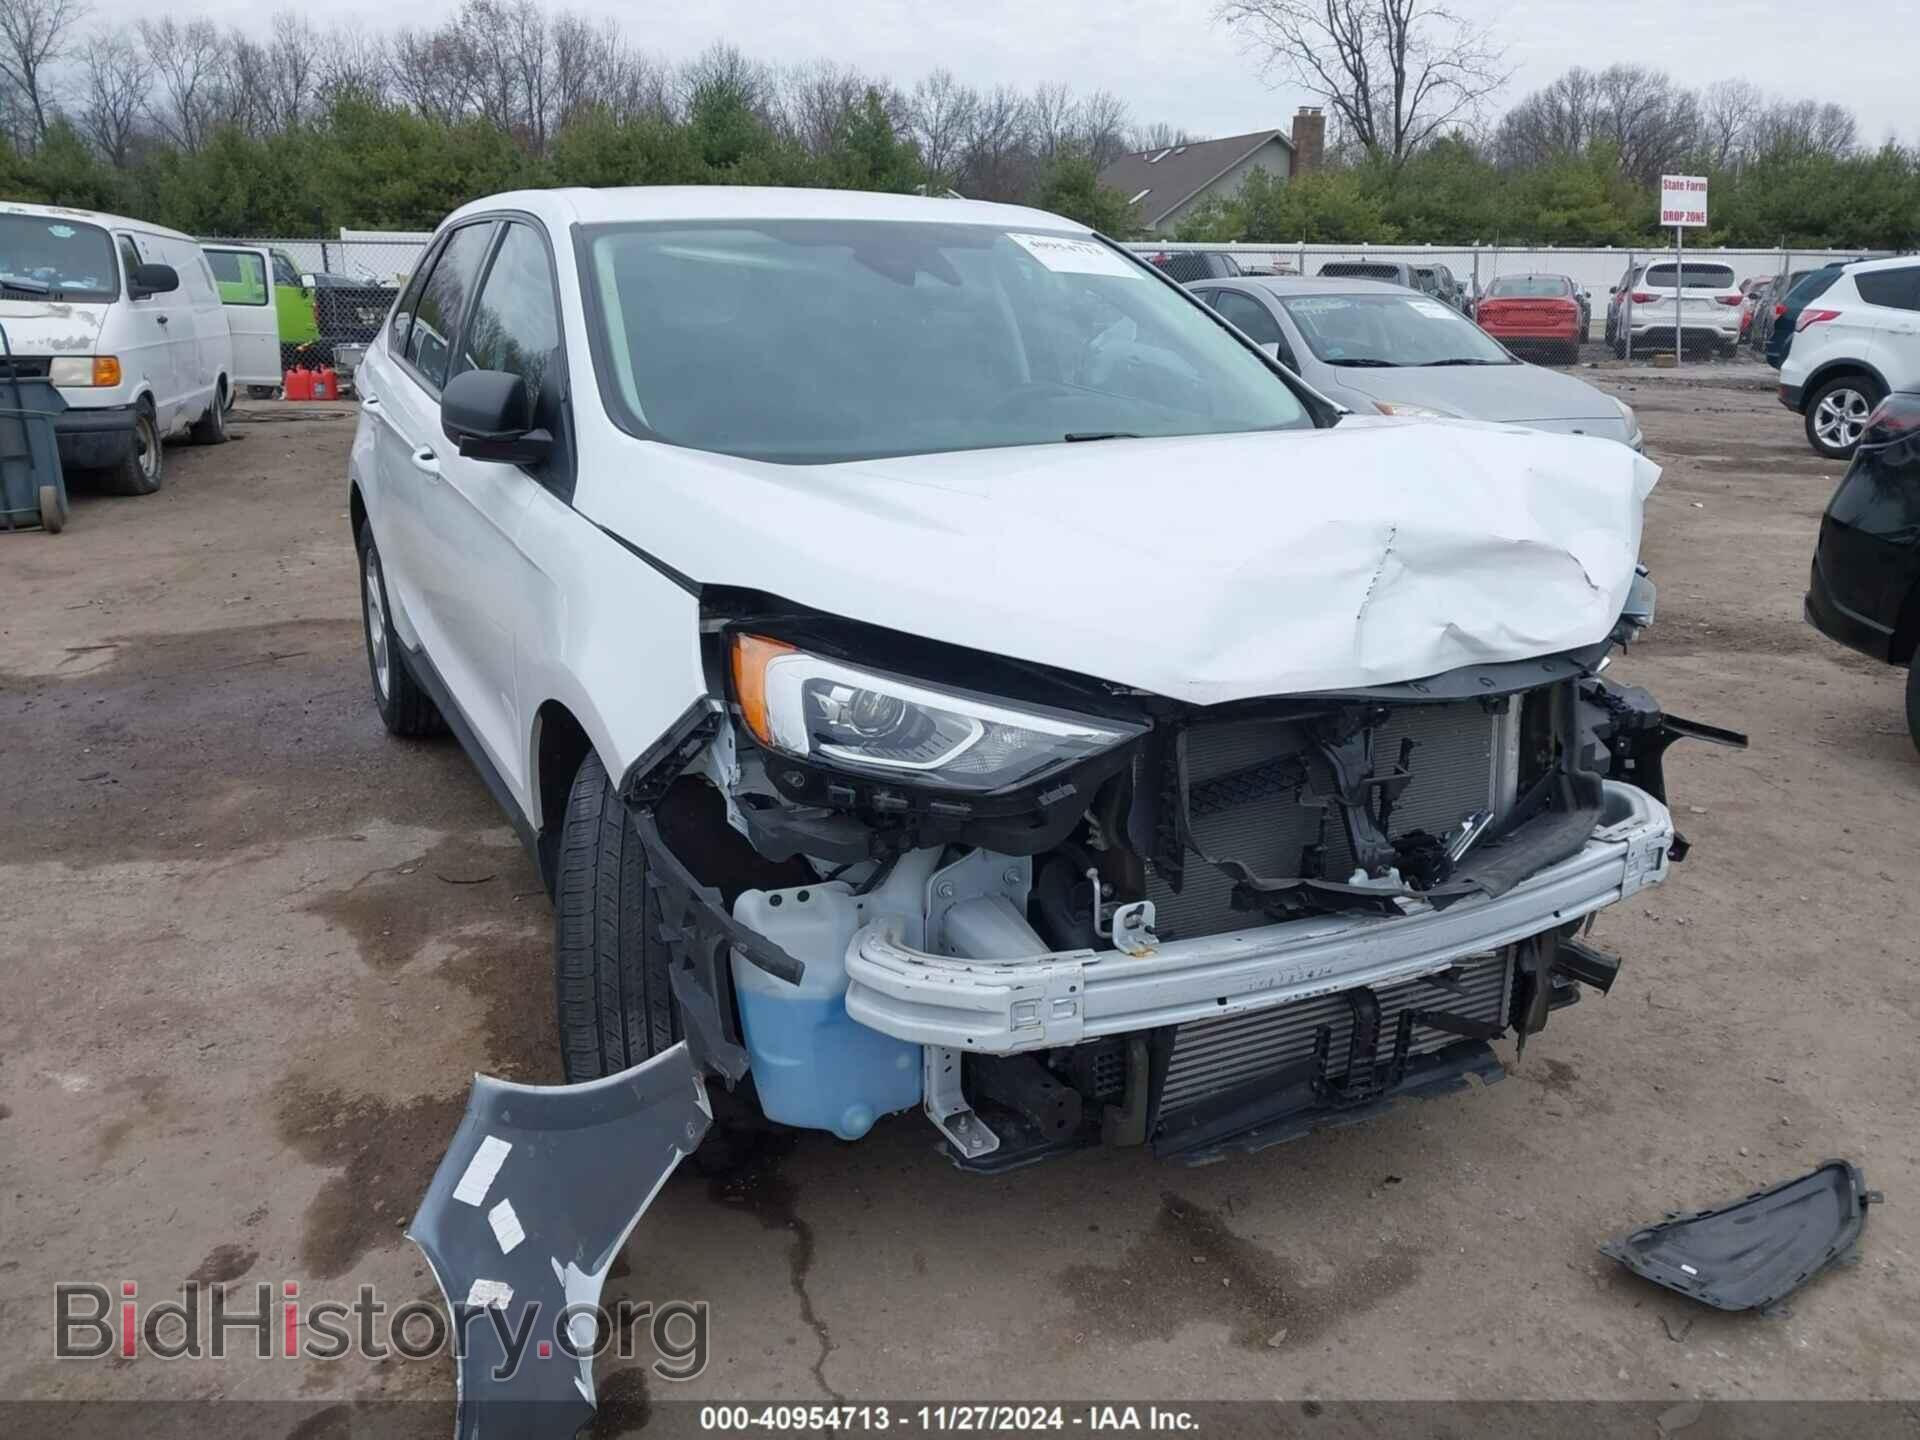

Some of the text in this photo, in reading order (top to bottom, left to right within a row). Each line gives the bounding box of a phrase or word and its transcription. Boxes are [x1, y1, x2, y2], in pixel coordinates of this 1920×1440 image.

[1663, 179, 1706, 191] State Farm
[1663, 210, 1705, 222] DROP ZONE
